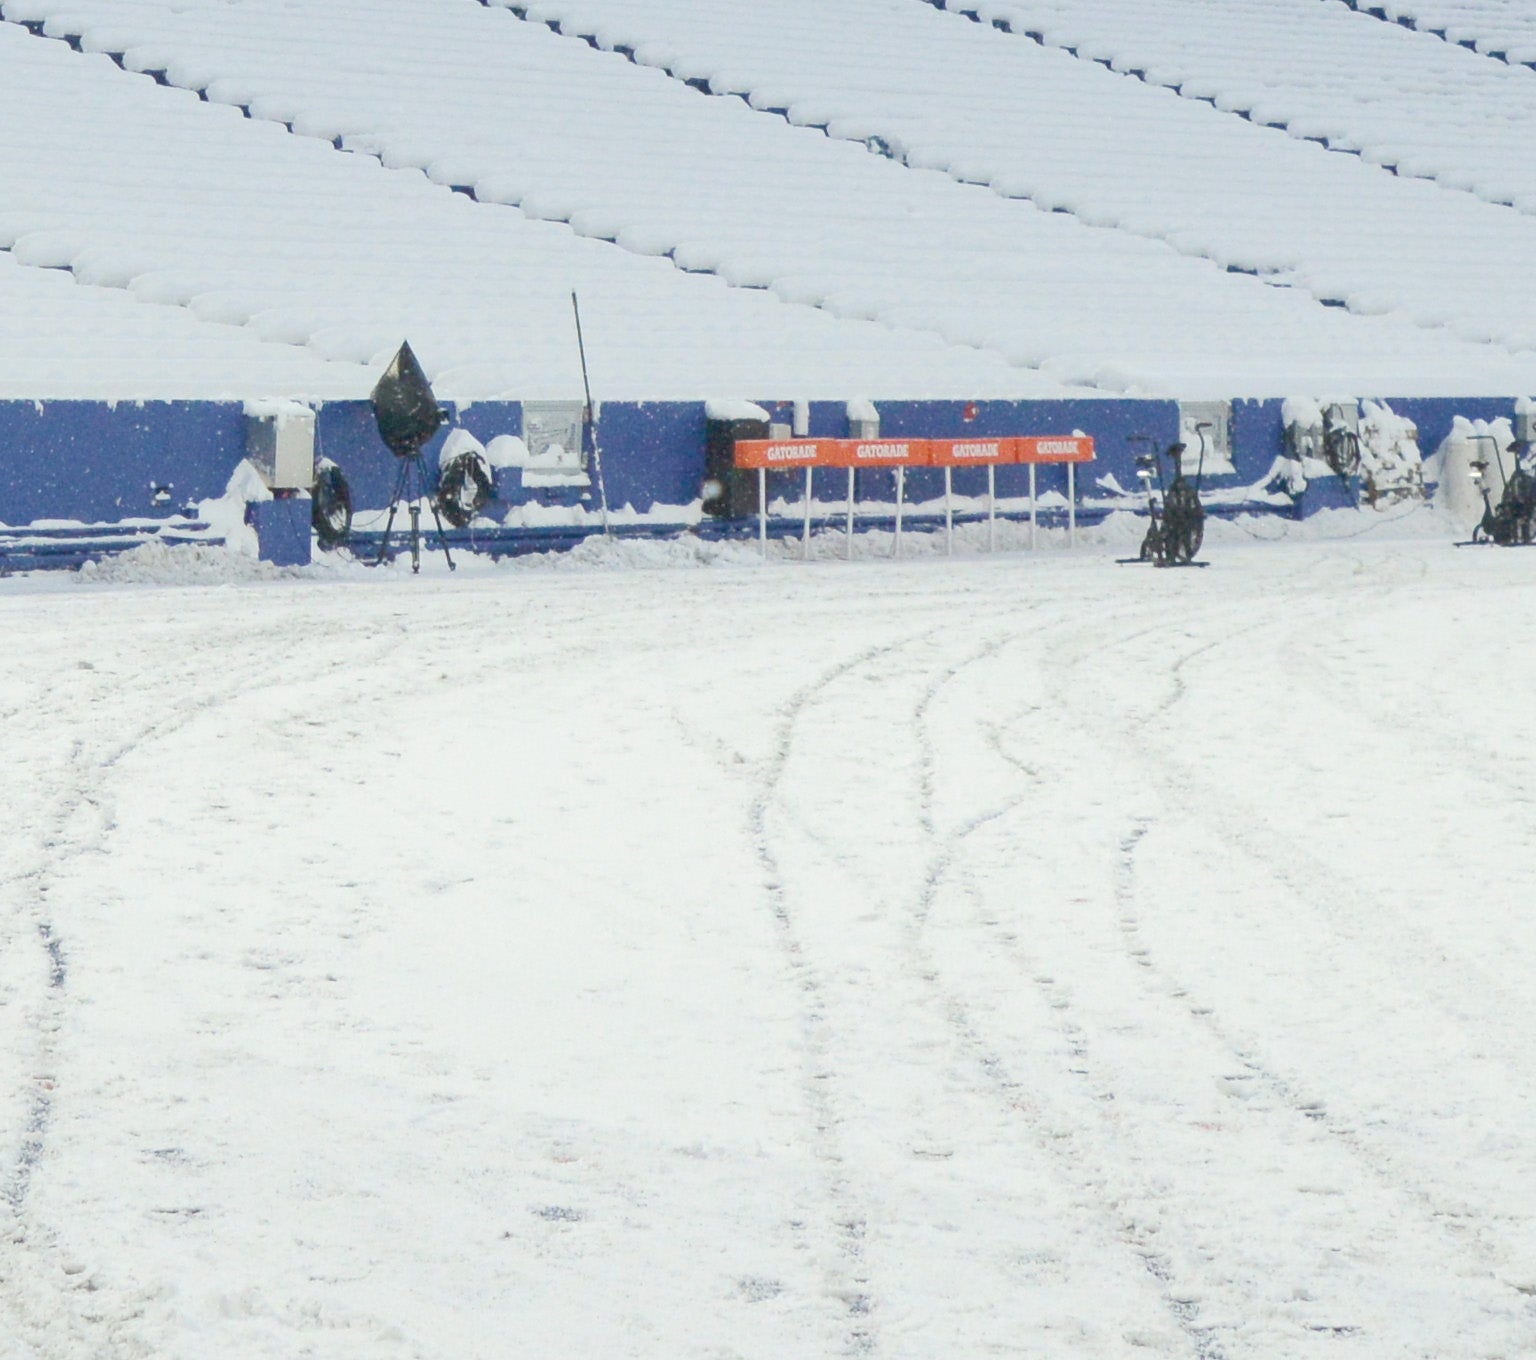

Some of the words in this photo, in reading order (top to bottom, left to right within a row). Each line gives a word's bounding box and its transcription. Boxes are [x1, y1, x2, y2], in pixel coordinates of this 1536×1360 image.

[767, 444, 817, 461] GATORADE
[856, 444, 909, 459] GATORADE
[952, 443, 998, 459] GATORADE
[1036, 440, 1079, 455] GATORADE
